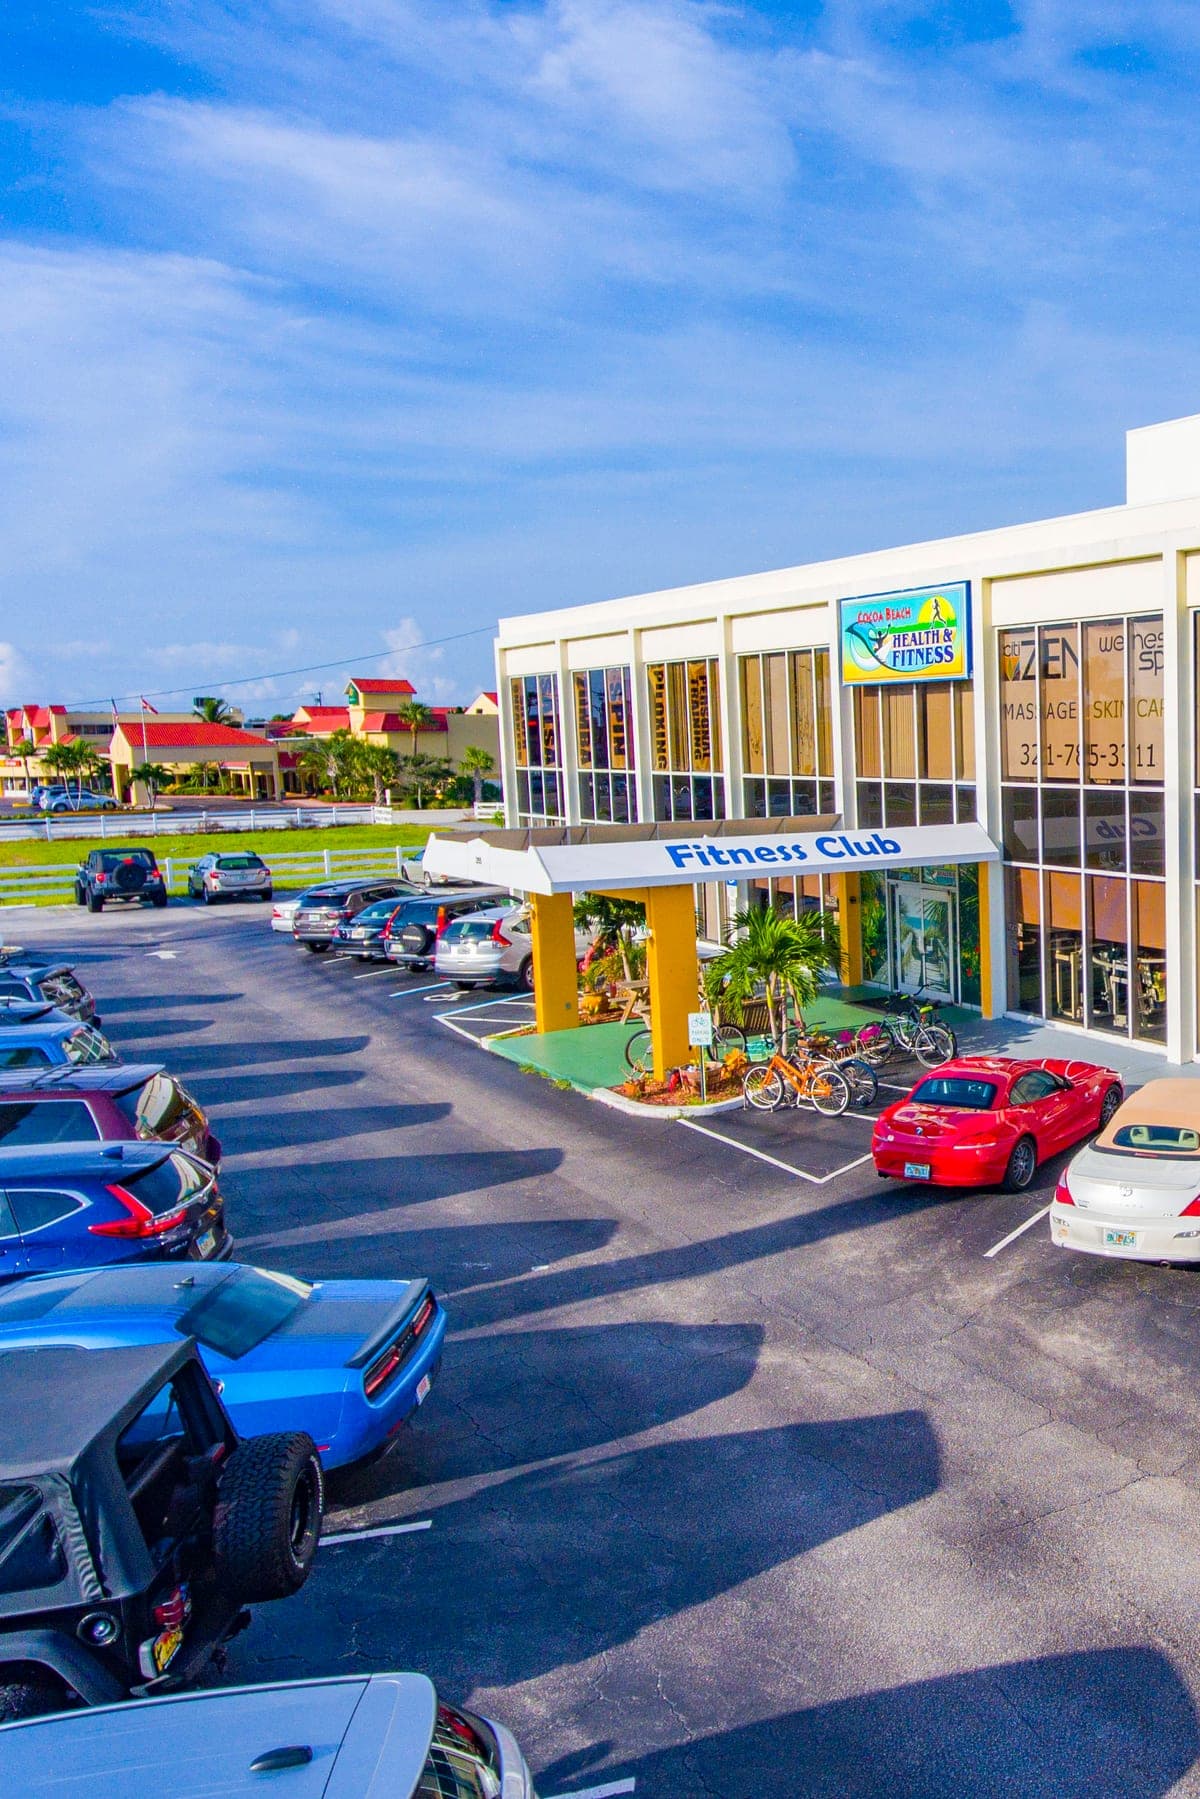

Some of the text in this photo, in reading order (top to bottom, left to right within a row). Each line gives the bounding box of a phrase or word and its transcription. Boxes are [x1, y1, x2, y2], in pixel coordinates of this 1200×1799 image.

[858, 607, 911, 623] COCOA BEACH
[893, 628, 953, 648] HEALTH &
[893, 645, 954, 667] FITNESS
[609, 682, 626, 755] SPIN
[1004, 702, 1077, 720] MASAGE
[665, 834, 902, 868] Fitness Club
